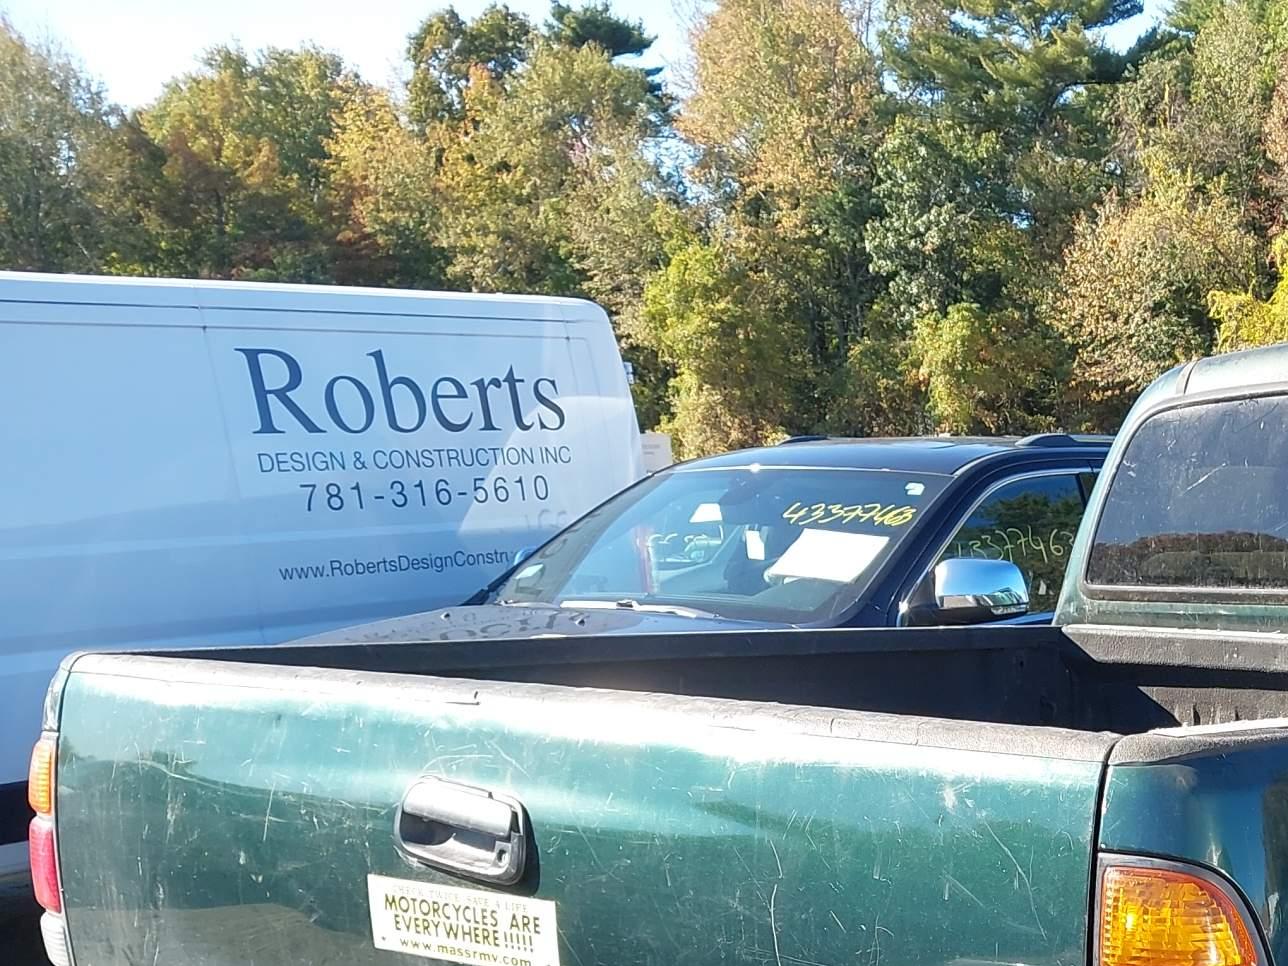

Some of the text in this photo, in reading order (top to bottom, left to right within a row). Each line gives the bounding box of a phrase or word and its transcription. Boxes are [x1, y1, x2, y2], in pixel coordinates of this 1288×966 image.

[234, 348, 566, 434] Roberts
[257, 446, 572, 473] DESIGN & CONSTRUCTION INC
[300, 475, 550, 512] 781-316-5610
[384, 893, 541, 935] MOTORCYCLES ARE
